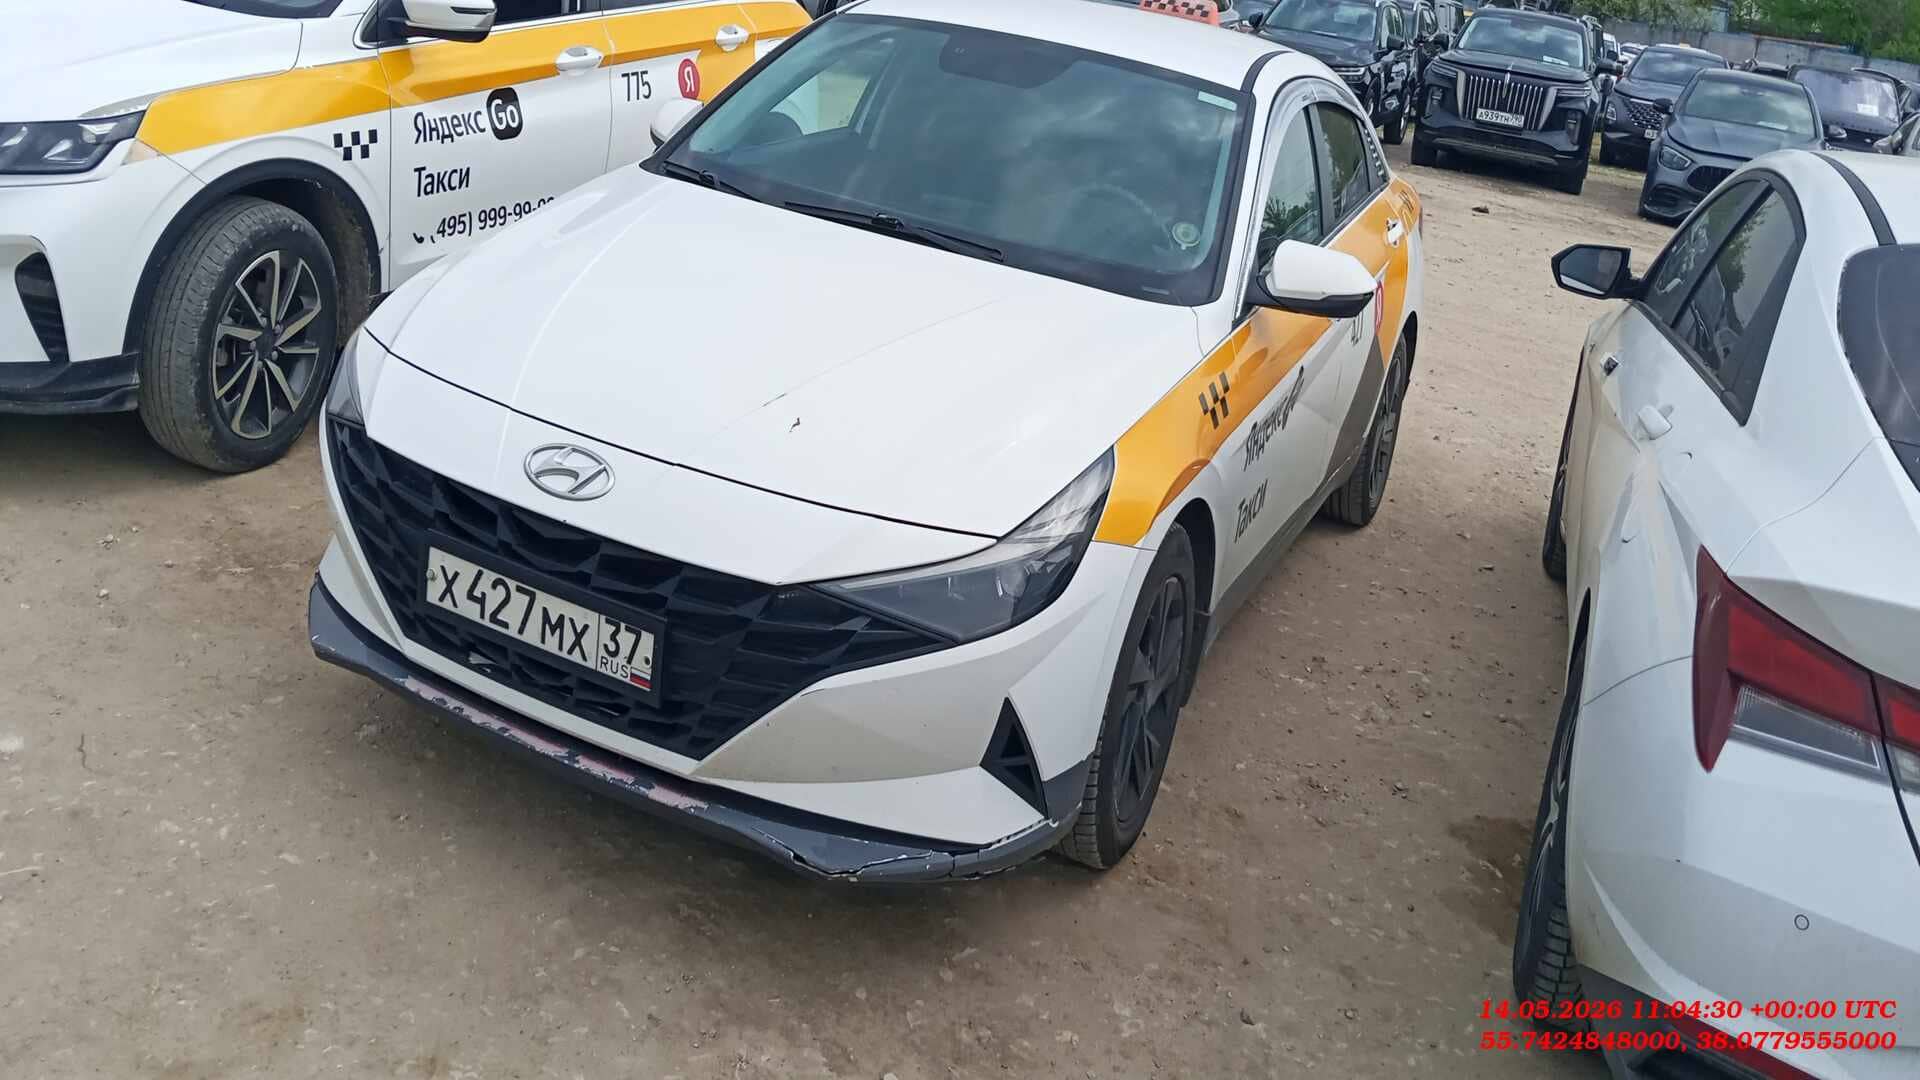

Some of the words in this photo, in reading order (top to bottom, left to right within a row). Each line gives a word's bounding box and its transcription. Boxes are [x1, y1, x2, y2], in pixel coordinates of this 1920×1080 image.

[621, 70, 652, 102] 775
[413, 111, 486, 144] Яндекс
[490, 98, 520, 130] Go
[413, 165, 470, 198] Такси
[438, 564, 590, 662] Х427МХ
[602, 616, 643, 666] 37
[599, 655, 629, 678] RUS
